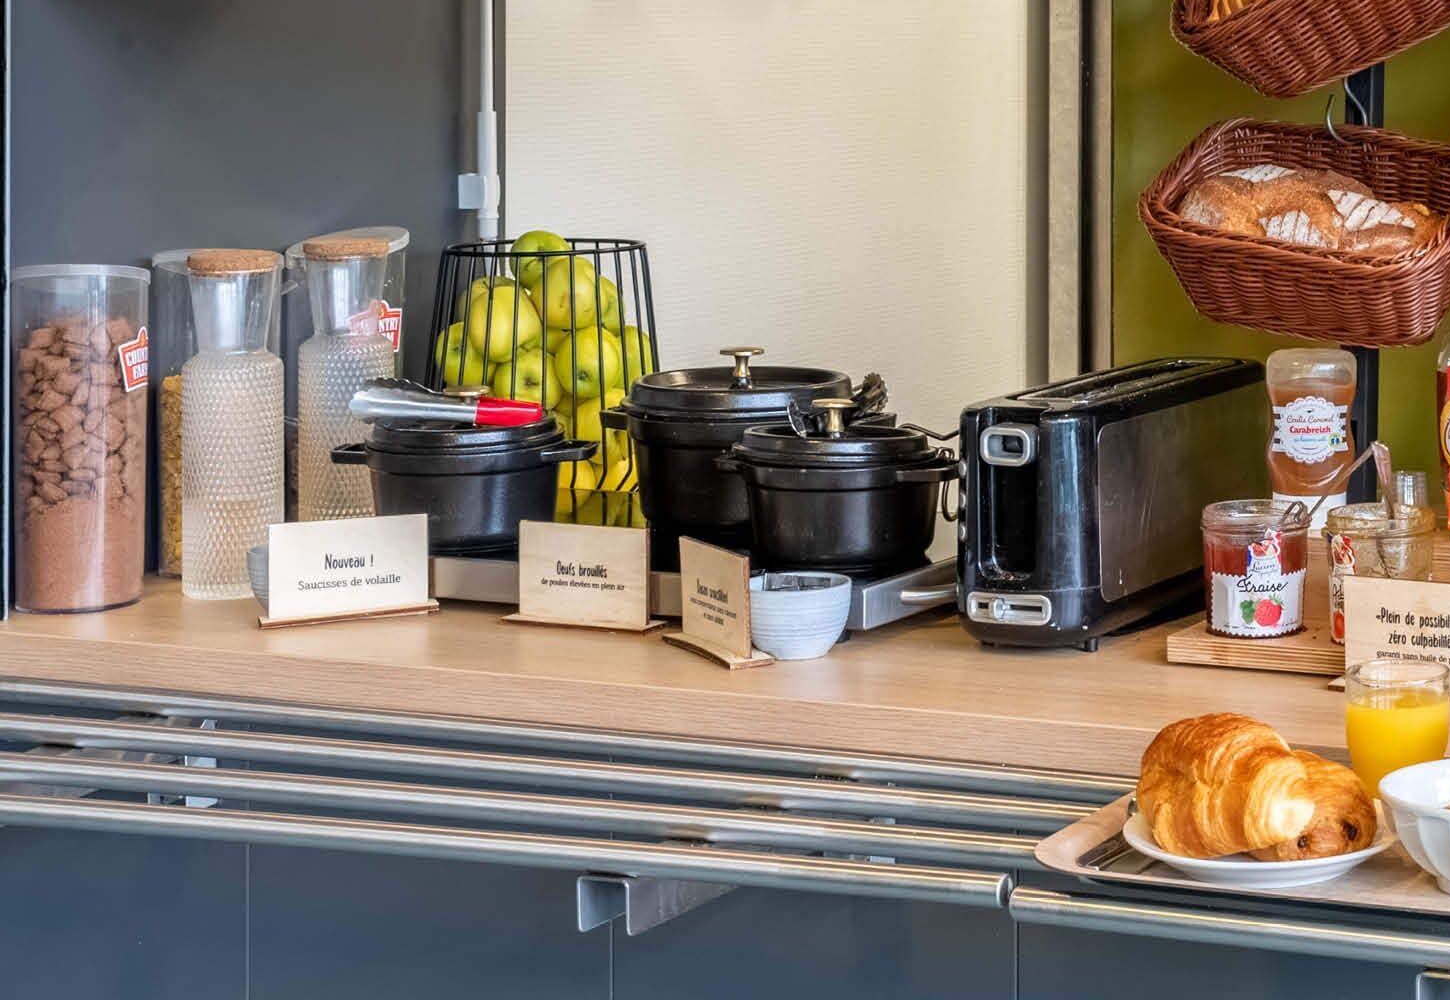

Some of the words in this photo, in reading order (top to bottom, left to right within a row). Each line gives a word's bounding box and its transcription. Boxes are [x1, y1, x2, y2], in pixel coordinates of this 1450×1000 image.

[325, 553, 366, 570] Nouveau
[370, 553, 374, 567] !
[556, 560, 575, 576] Oeufs
[579, 563, 607, 579] brouillés
[298, 580, 347, 591] Saucisses
[350, 577, 362, 587] de
[365, 574, 401, 585] volaille
[1237, 574, 1288, 593] Fraise
[1405, 612, 1415, 626] de
[1388, 630, 1407, 644] zéro
[1377, 650, 1400, 658] garanti
[1420, 654, 1436, 662] huile
